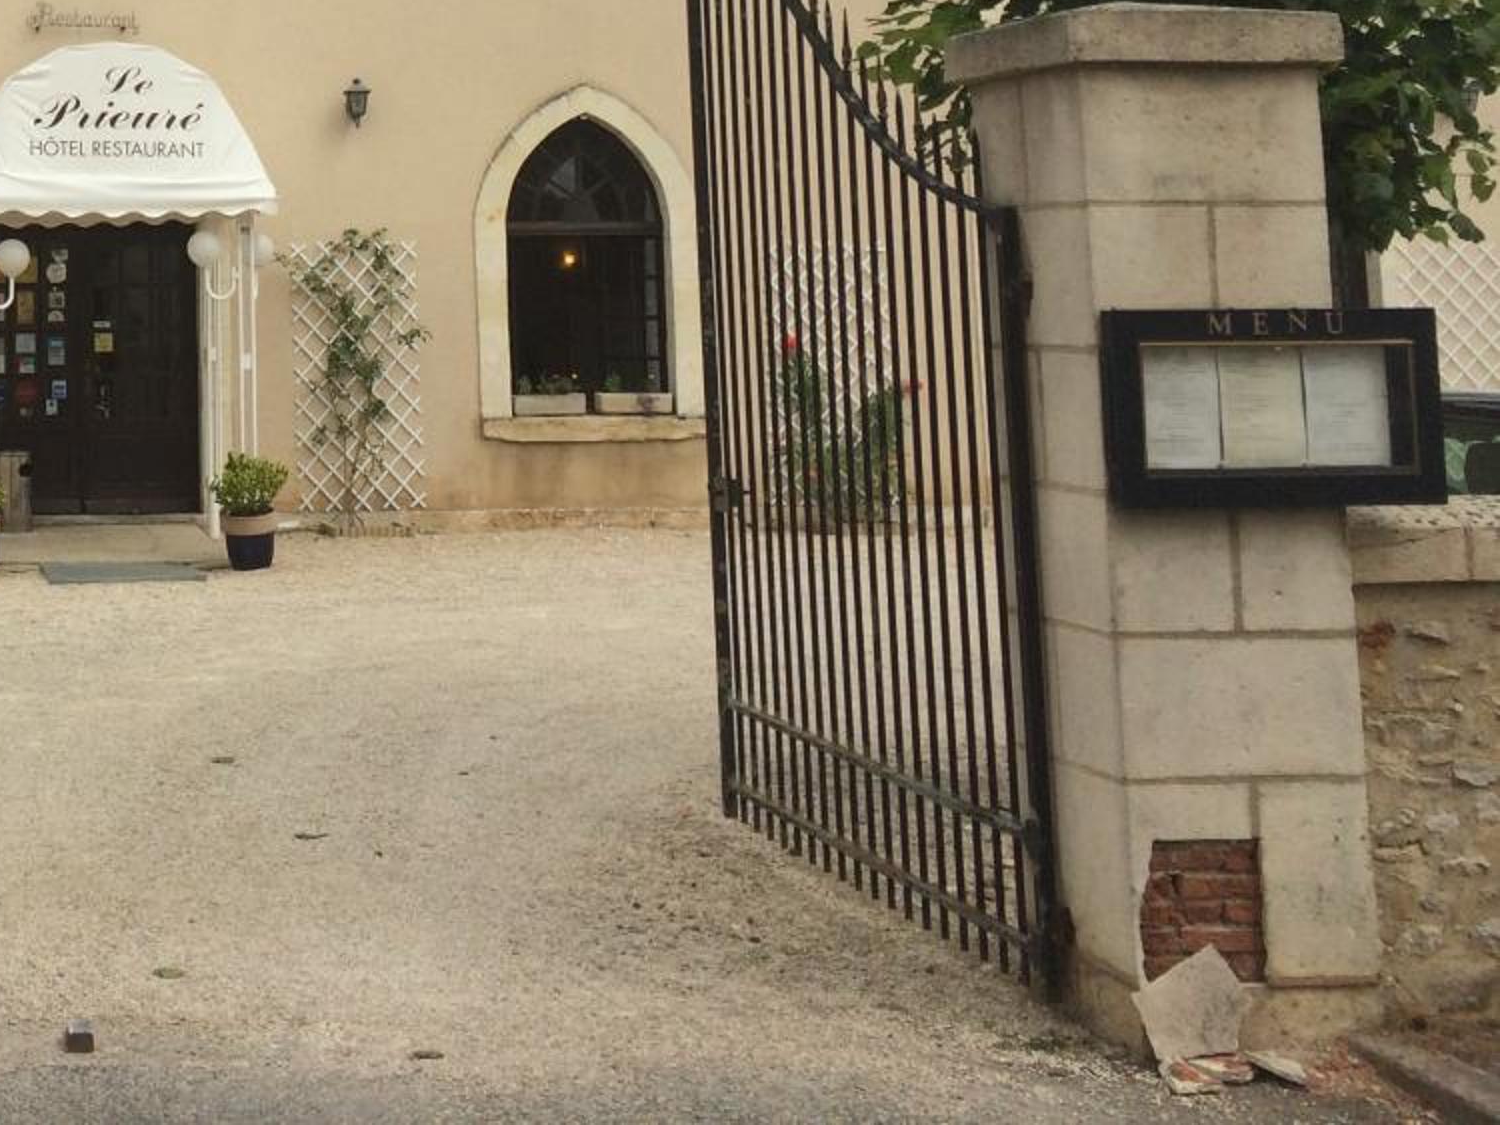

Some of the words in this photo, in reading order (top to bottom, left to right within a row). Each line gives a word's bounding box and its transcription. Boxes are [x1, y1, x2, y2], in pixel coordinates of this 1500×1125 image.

[28, 1, 138, 31] Restaurant
[105, 66, 153, 94] Le
[33, 94, 204, 129] Prieuré
[29, 137, 86, 156] HÔTEL
[92, 140, 204, 158] RESTAURANT
[1207, 312, 1344, 335] MENU
